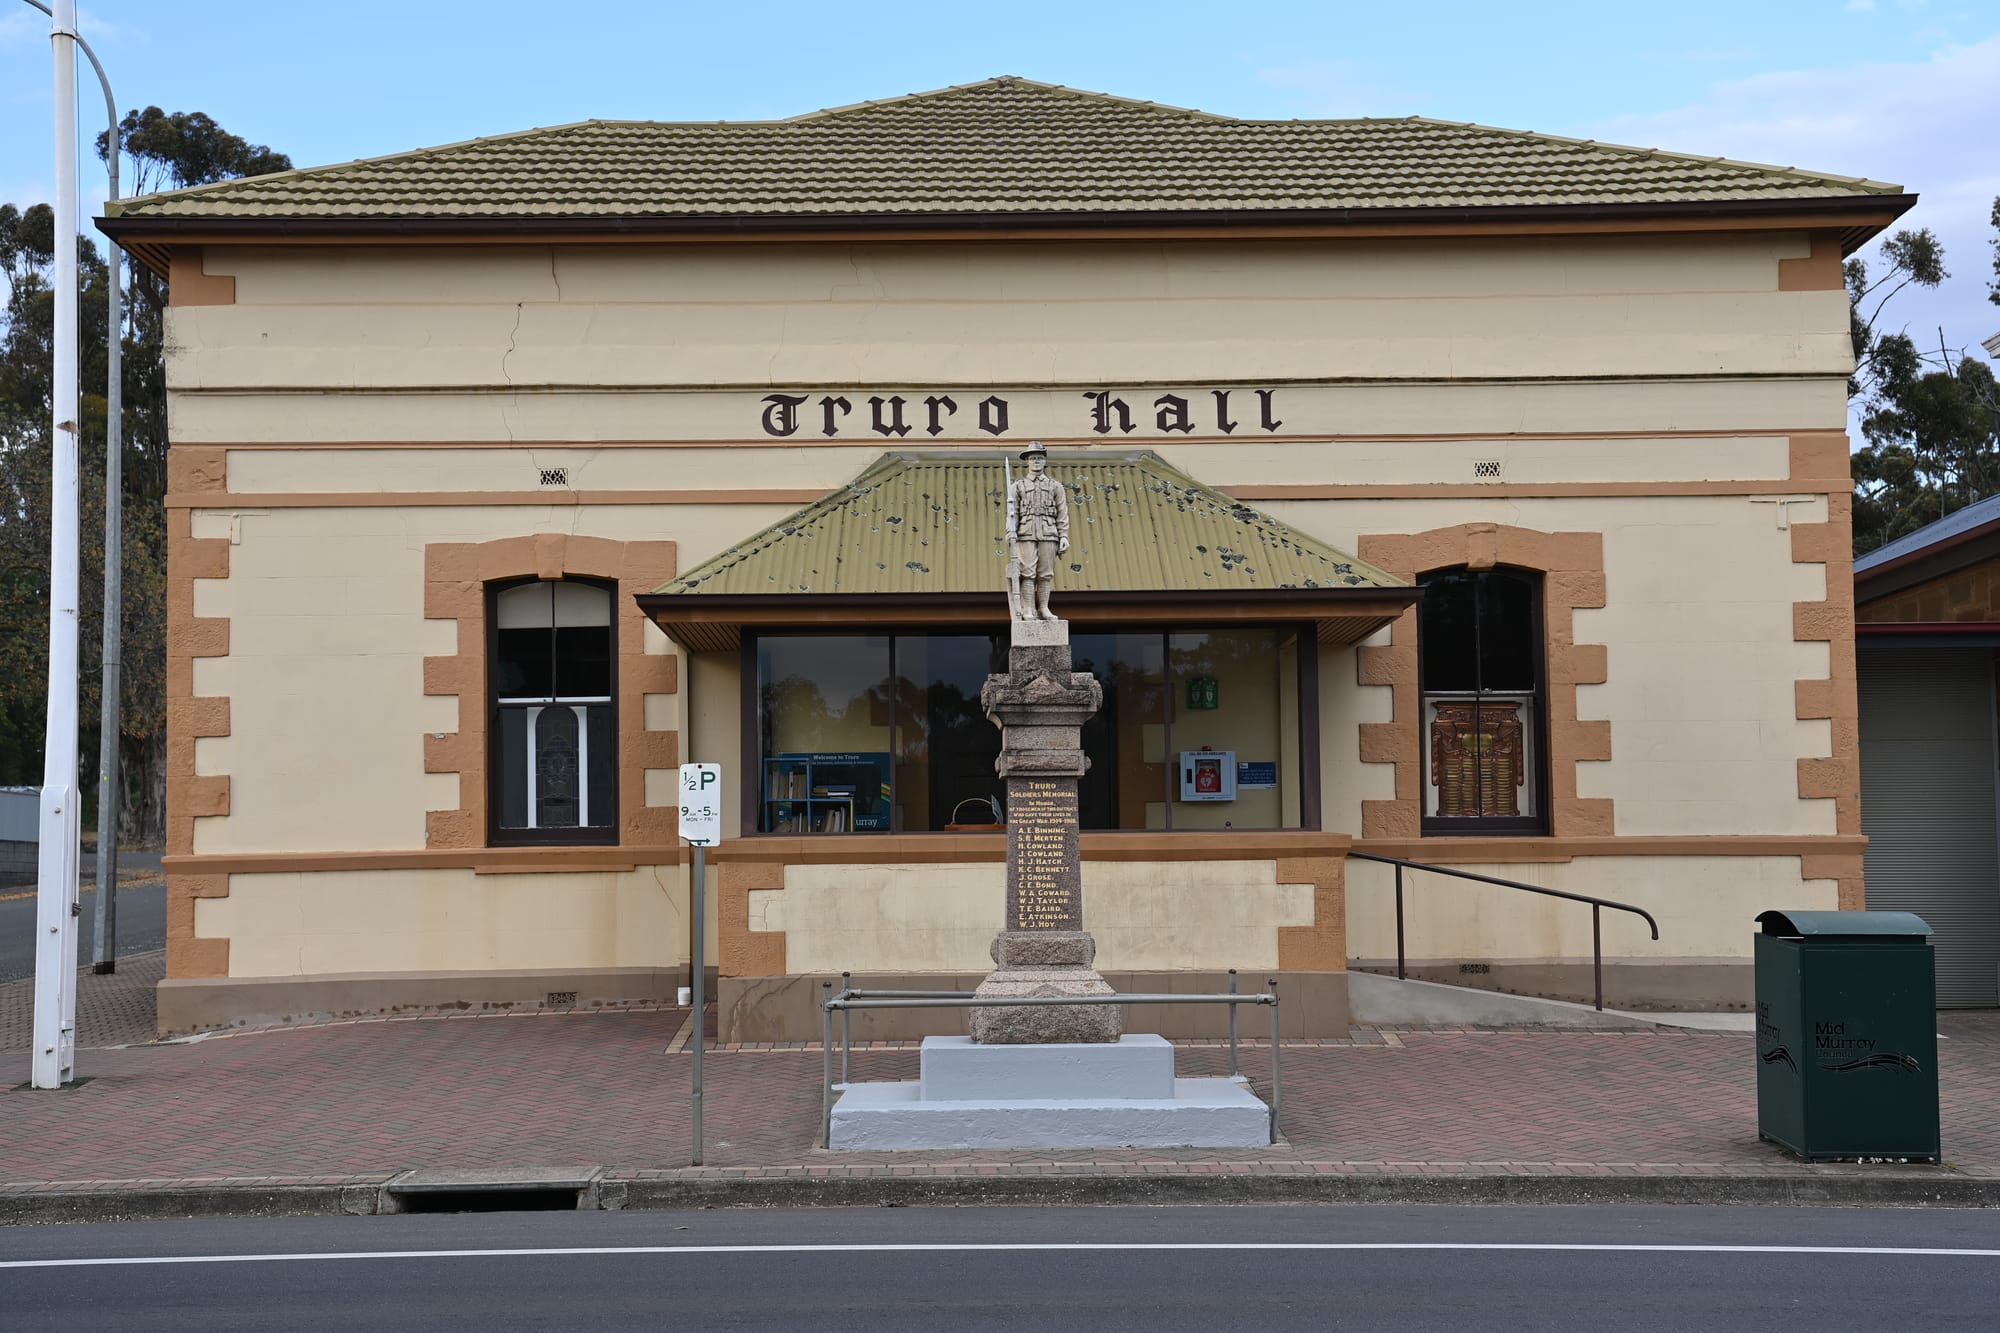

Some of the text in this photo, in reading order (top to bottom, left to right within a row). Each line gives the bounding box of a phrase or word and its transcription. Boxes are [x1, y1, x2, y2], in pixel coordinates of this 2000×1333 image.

[761, 394, 1009, 437] Truro
[1028, 781, 1057, 790] TRURO
[1815, 1021, 1846, 1035] Mid
[1815, 1035, 1878, 1052] Murray
